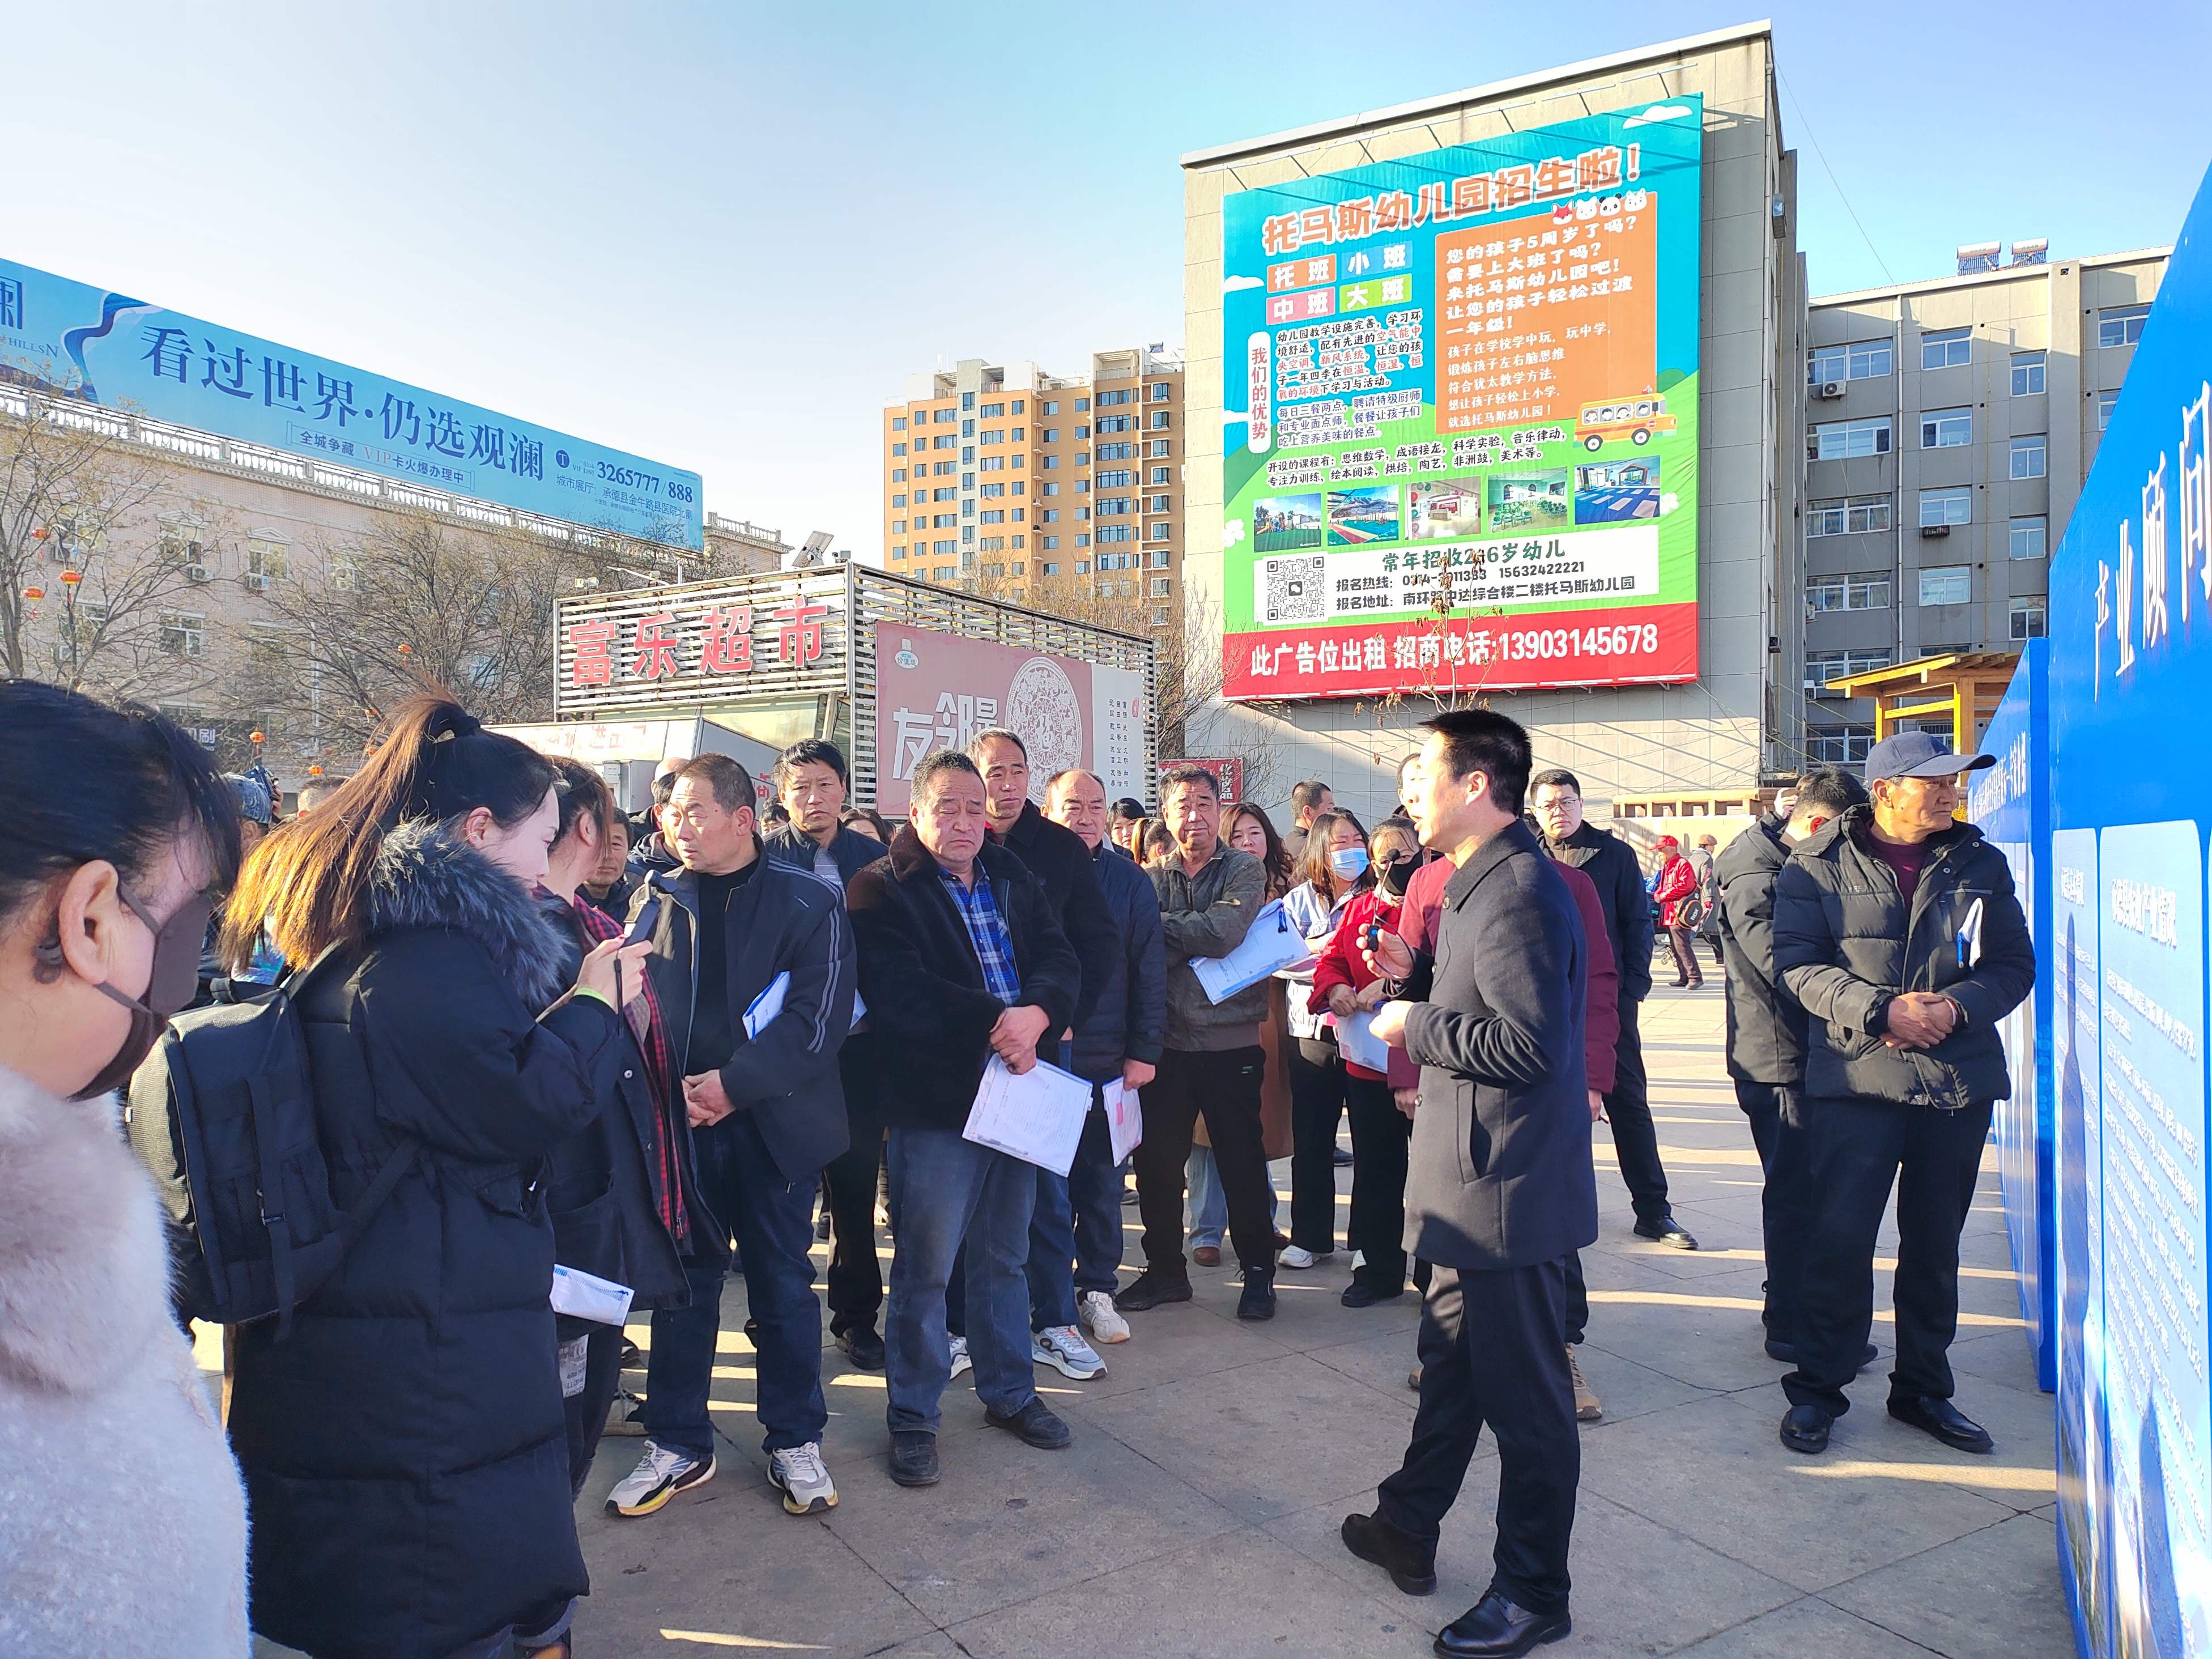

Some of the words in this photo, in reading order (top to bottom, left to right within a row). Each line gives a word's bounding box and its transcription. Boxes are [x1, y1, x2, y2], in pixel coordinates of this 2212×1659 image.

[1264, 144, 1640, 254] 托马斯幼儿园招生啦！
[1446, 215, 1637, 264] 您的孩子5周岁了吗？
[1446, 243, 1601, 283] 需要上大班了吗？
[1446, 258, 1620, 301] 来托马斯幼儿园吧！
[1446, 276, 1634, 320] 让您的孩子轻松过渡
[1446, 316, 1513, 335] 一年级！
[1447, 347, 1566, 376] 锻炼孩子左右脑思维
[1251, 347, 1268, 440] 我们的优势
[1448, 405, 1551, 428] 就选托马斯幼儿园！
[300, 431, 355, 456] 全城争藏
[2094, 380, 2212, 703] 产业顾问
[1499, 561, 1584, 578] 15632422221
[568, 594, 828, 688] 富乐超市
[1250, 636, 1388, 677] 此广告位出租
